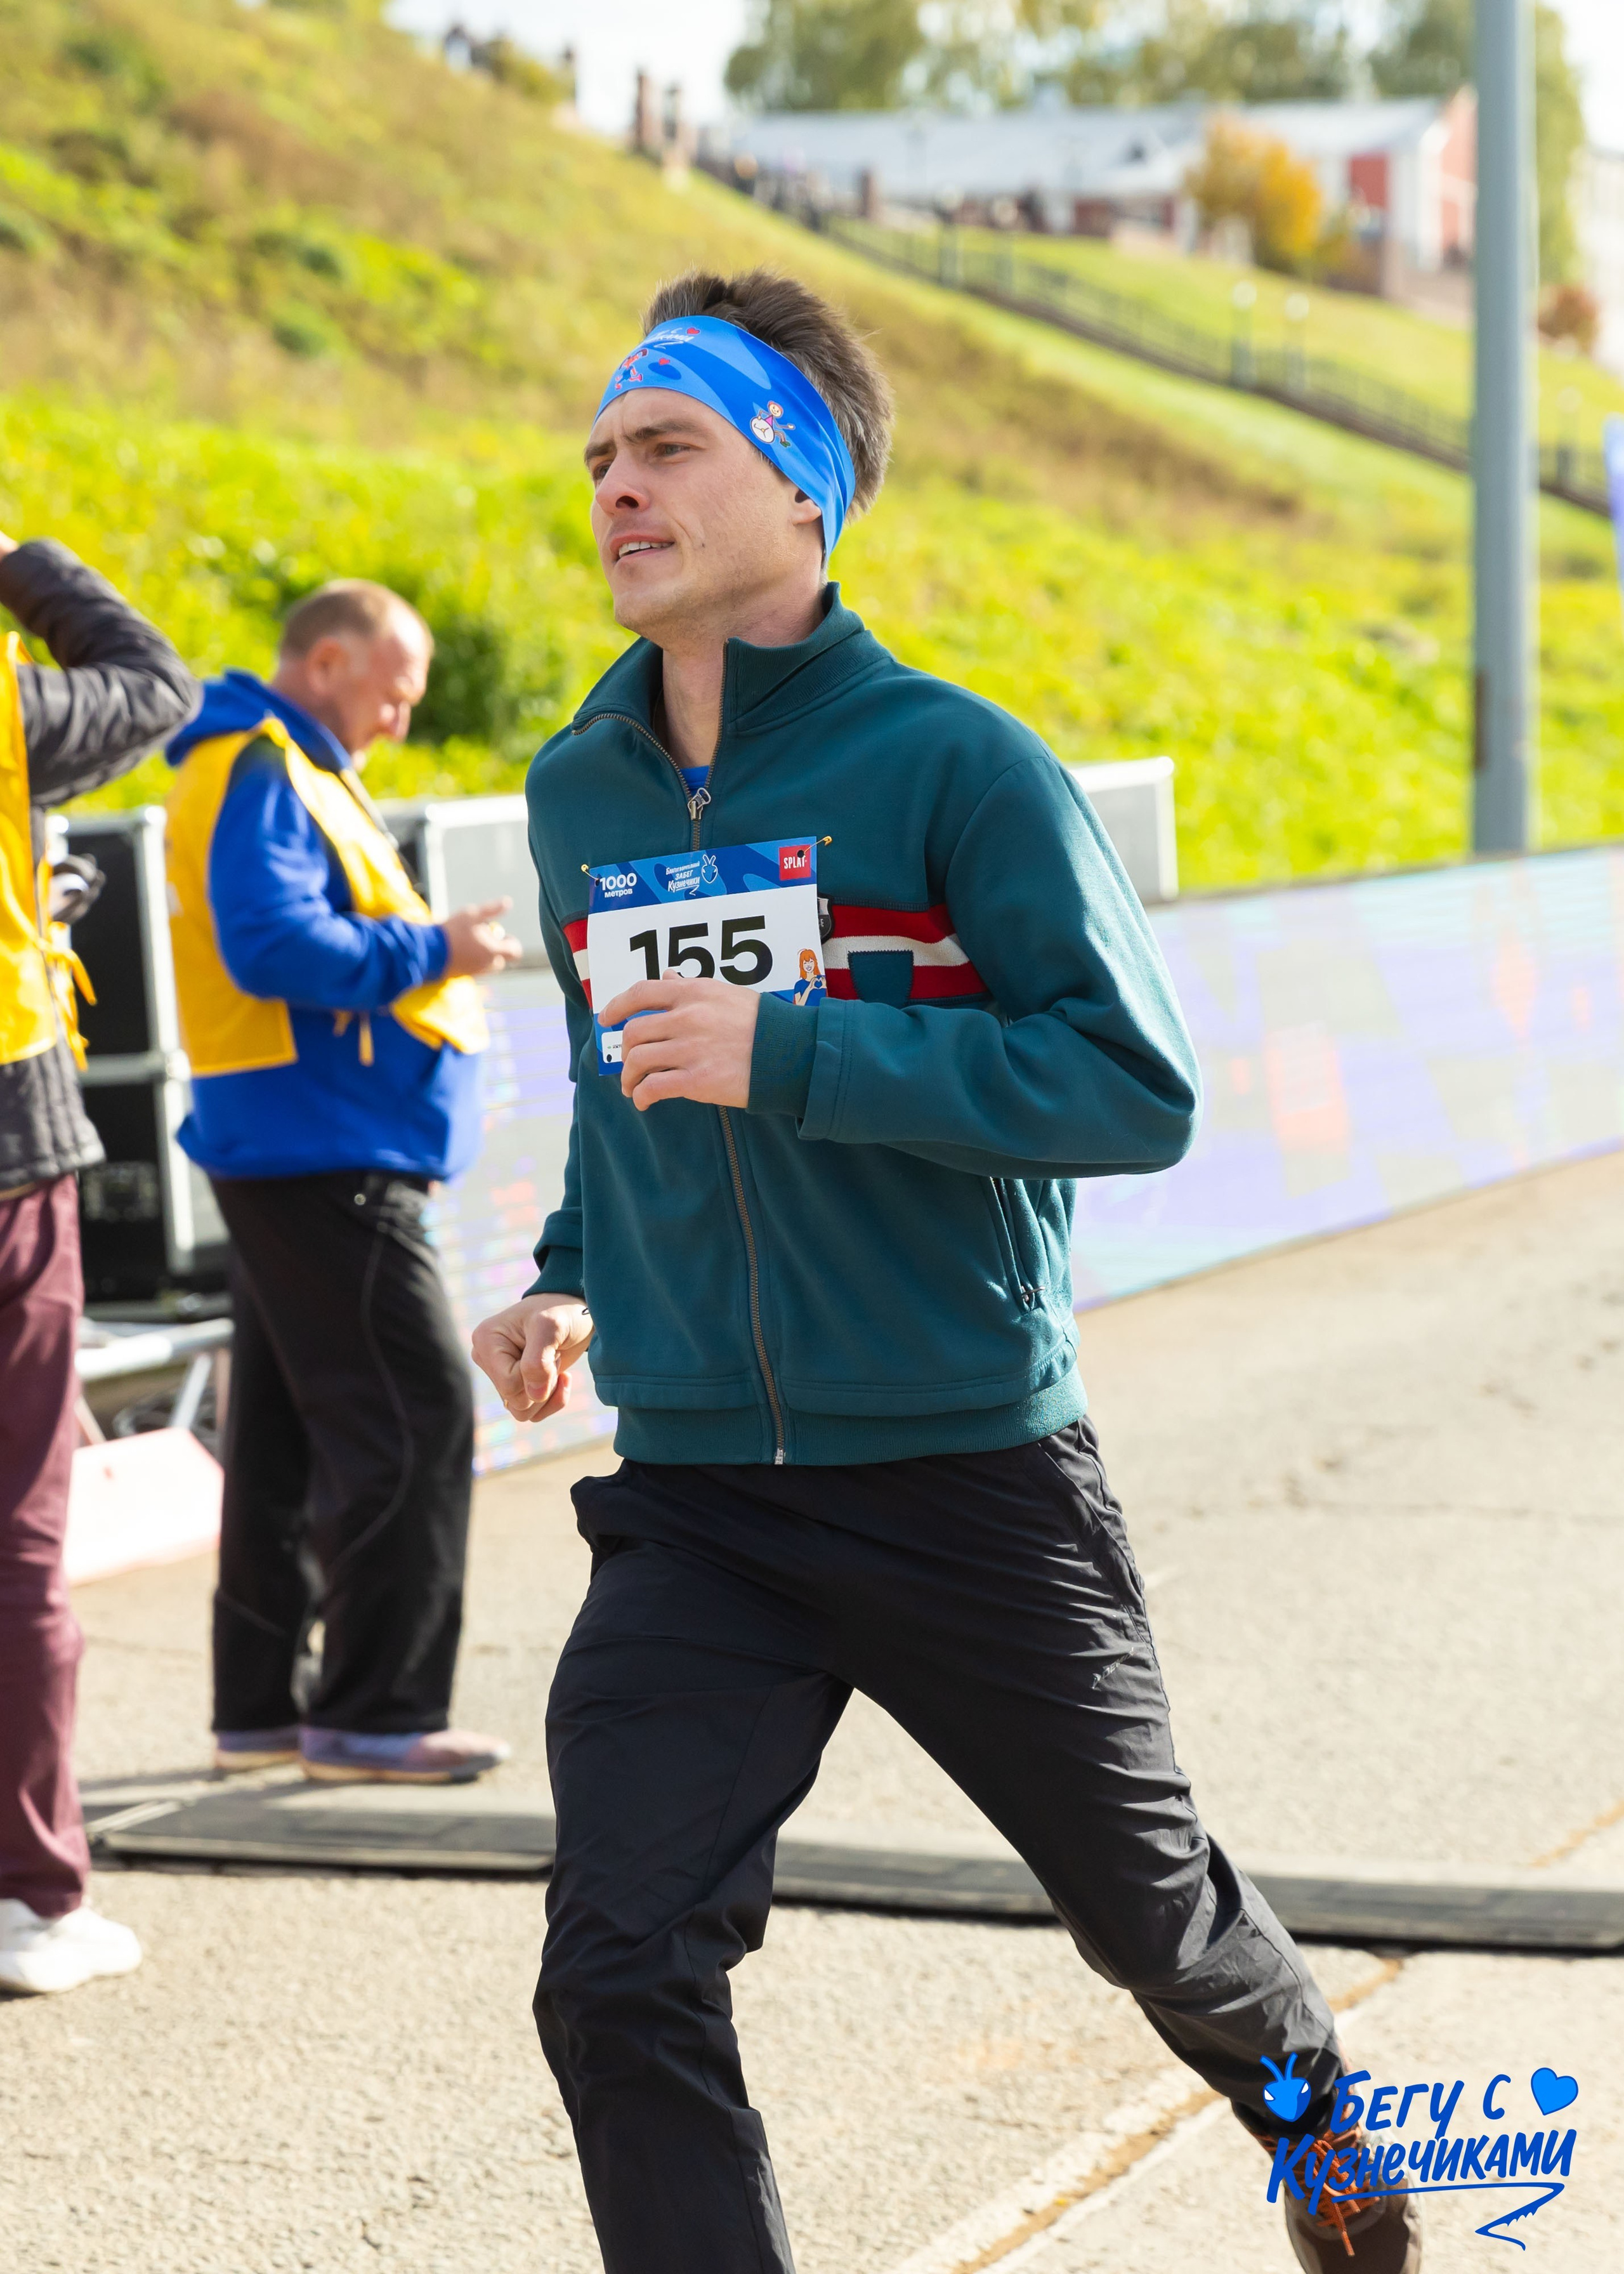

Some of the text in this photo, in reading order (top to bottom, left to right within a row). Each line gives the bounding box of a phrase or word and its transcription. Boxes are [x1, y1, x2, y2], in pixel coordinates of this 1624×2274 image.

[783, 854, 806, 869] SPLAT
[599, 872, 637, 891] 1000
[675, 870, 693, 880] ЗАБЕГ
[605, 888, 632, 898] метров
[629, 915, 773, 986] 155
